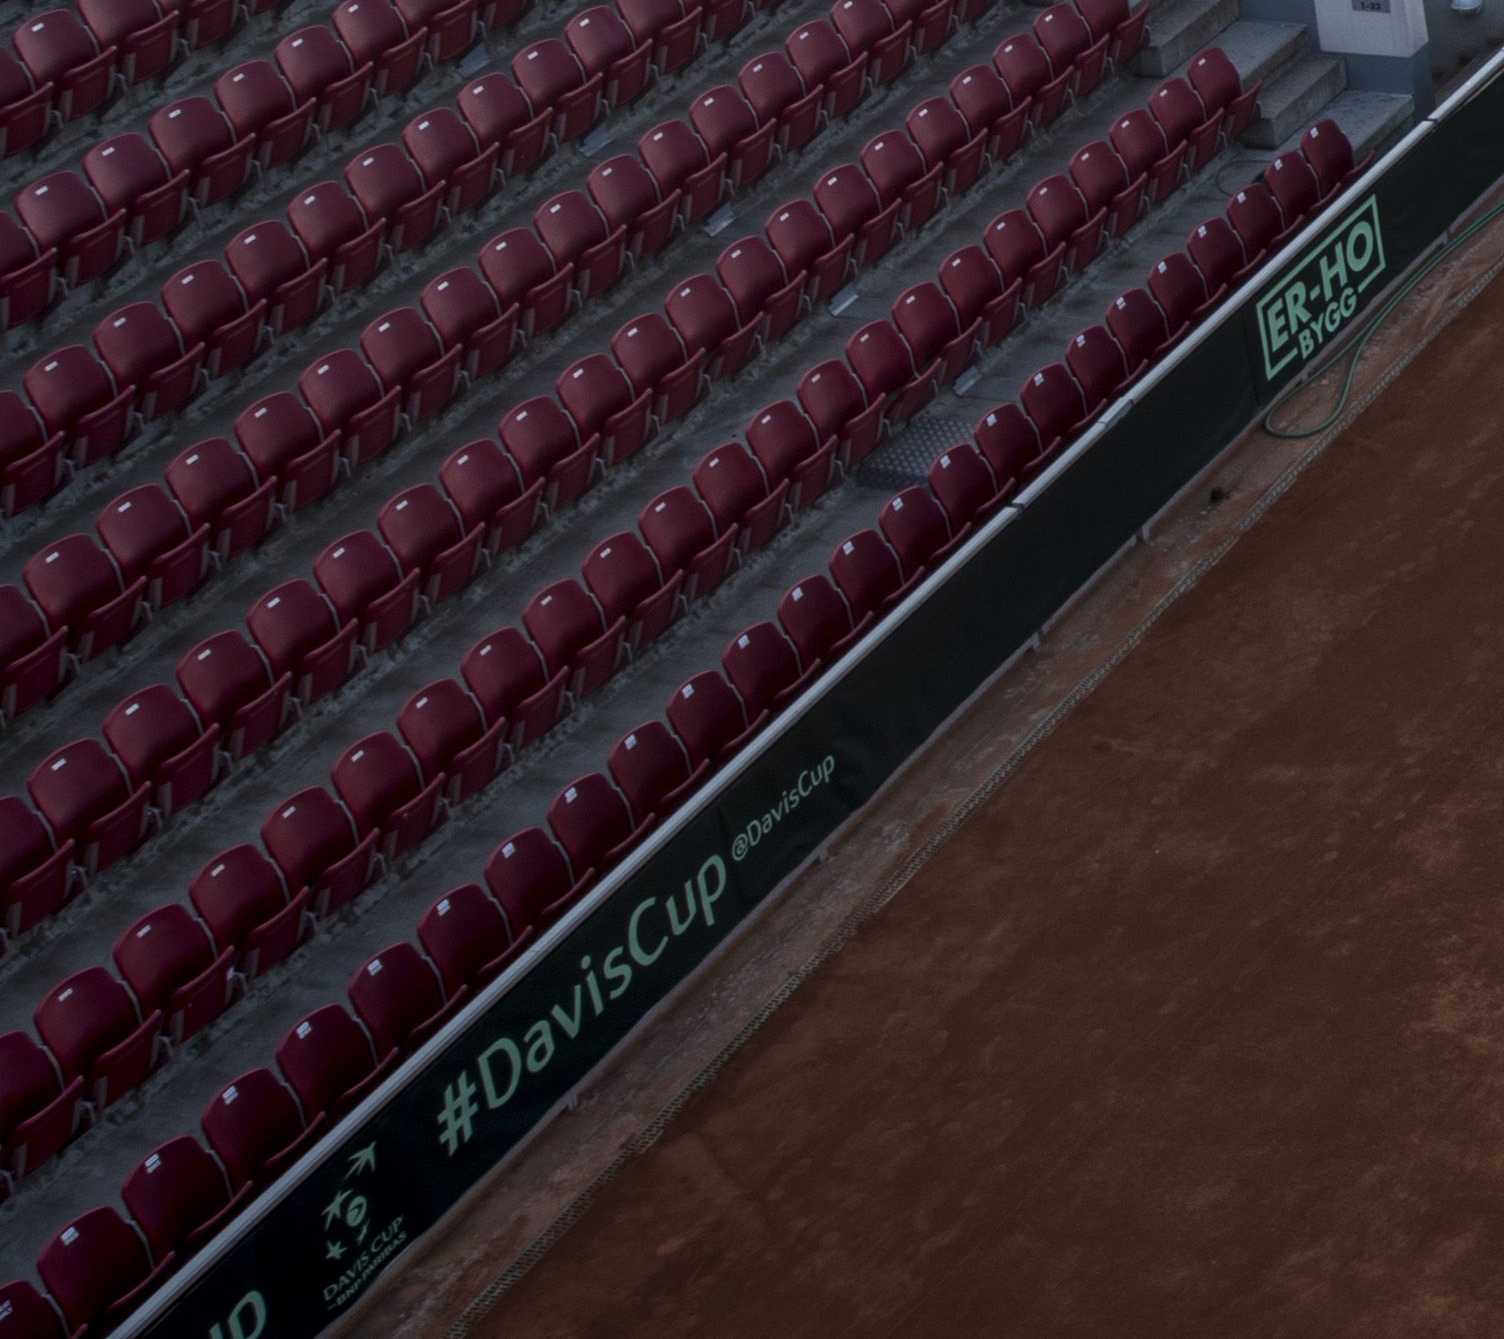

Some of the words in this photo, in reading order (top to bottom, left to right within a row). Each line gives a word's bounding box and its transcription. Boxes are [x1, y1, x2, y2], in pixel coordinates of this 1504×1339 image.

[1266, 220, 1374, 354] ER-HO
[1298, 286, 1358, 361] BYGG
[731, 754, 836, 862] @DavisCup
[437, 853, 727, 1157] #DavisCup
[322, 1251, 370, 1303] DAVIS
[370, 1214, 405, 1254] CUP
